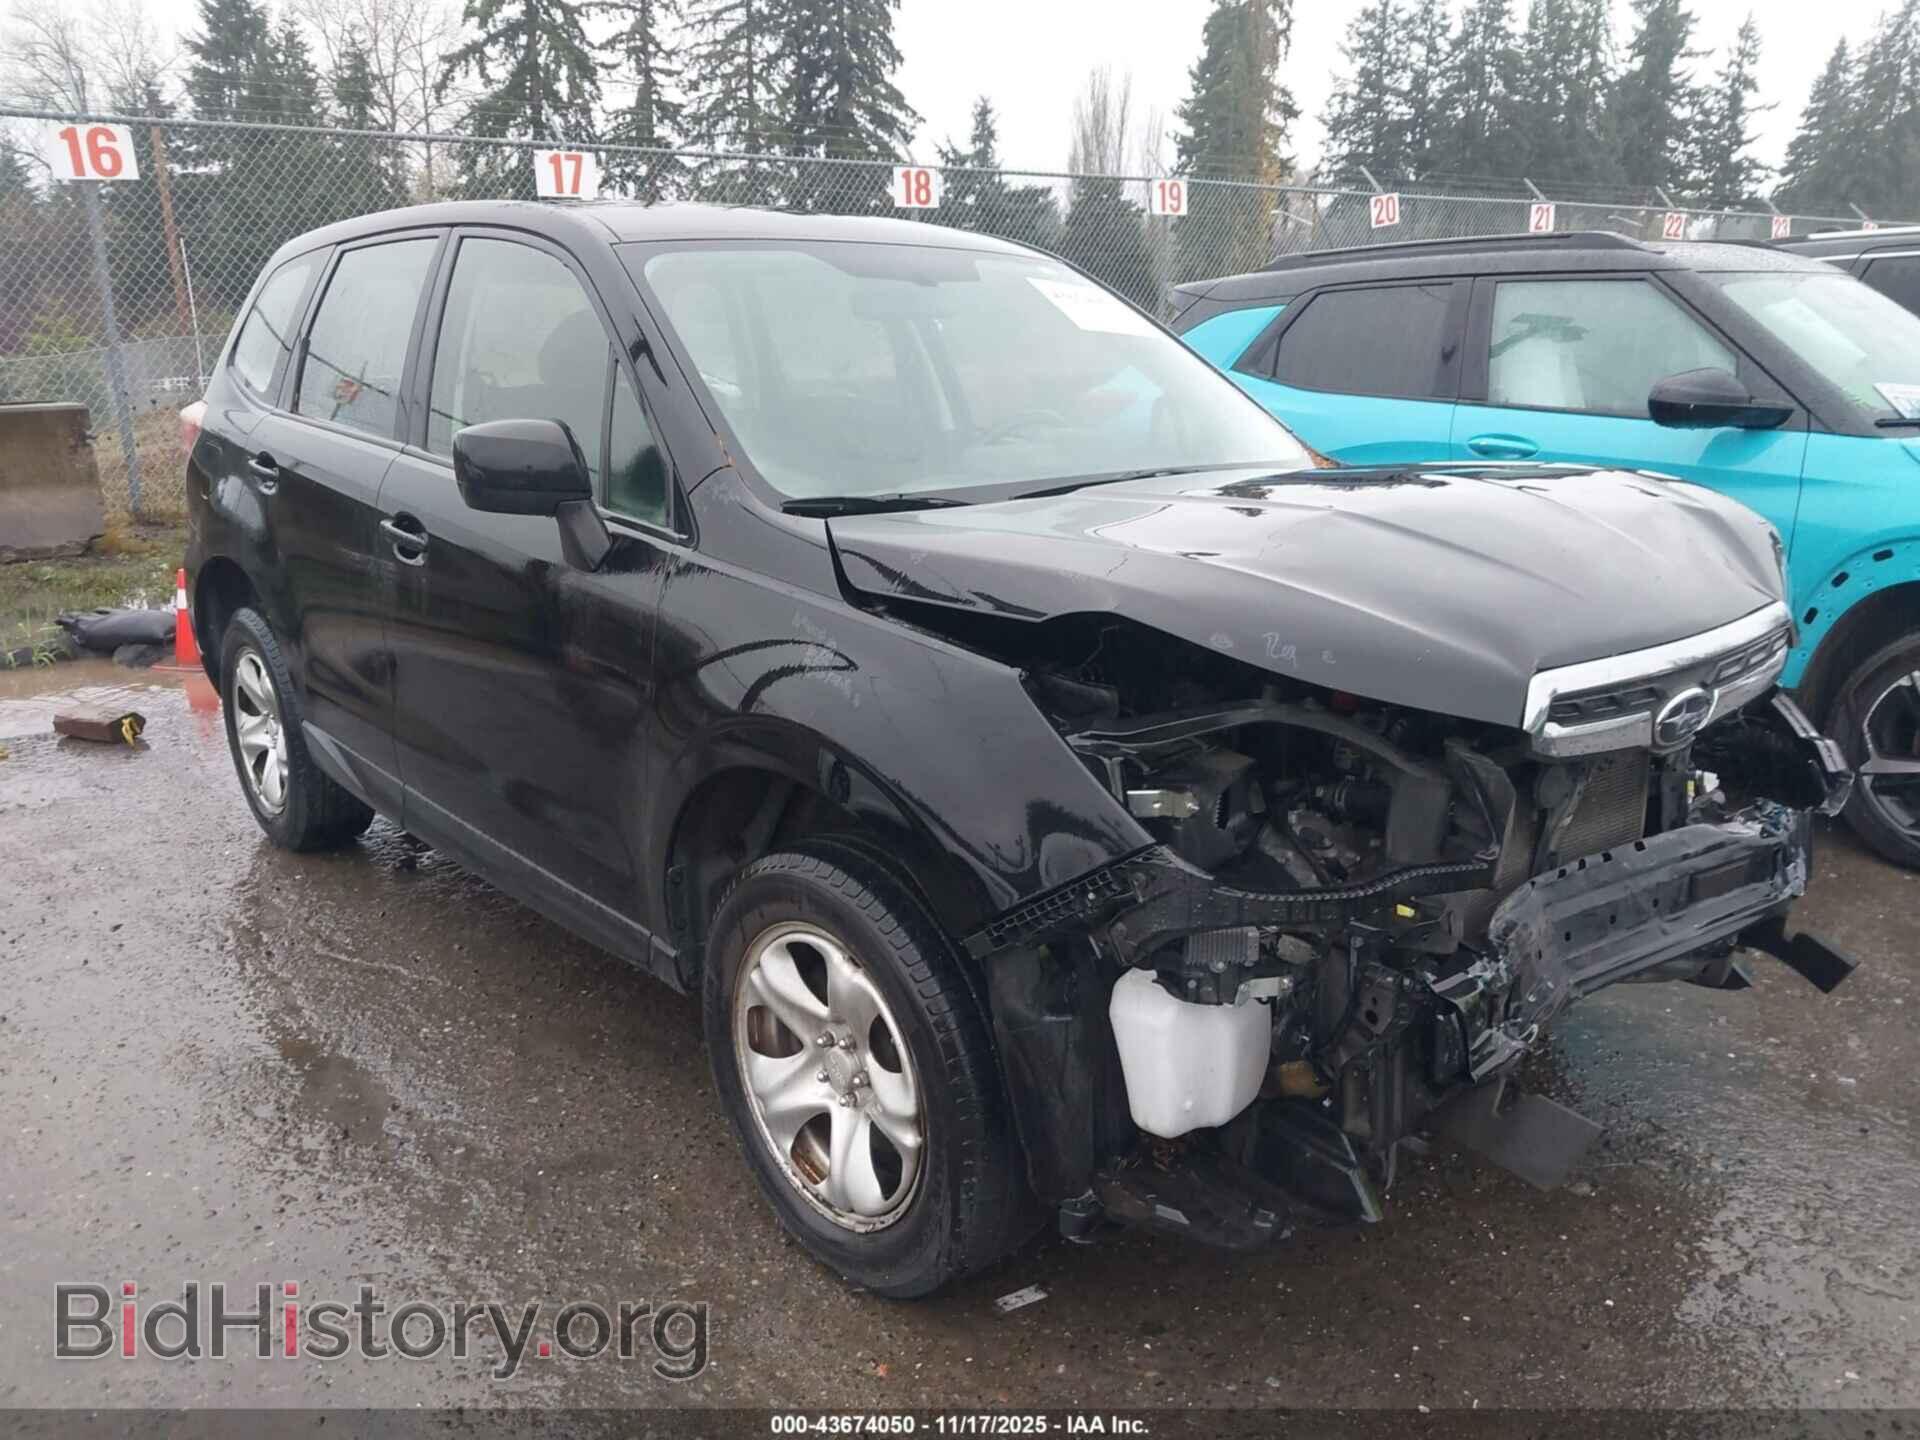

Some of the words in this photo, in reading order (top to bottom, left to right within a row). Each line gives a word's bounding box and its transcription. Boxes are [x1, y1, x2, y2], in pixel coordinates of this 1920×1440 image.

[59, 127, 123, 177] 16
[548, 153, 583, 194] 17
[902, 170, 931, 205] 18
[1159, 182, 1181, 213] 19
[1374, 196, 1396, 225] 20
[1535, 206, 1551, 230] 21
[1665, 215, 1682, 237] 22
